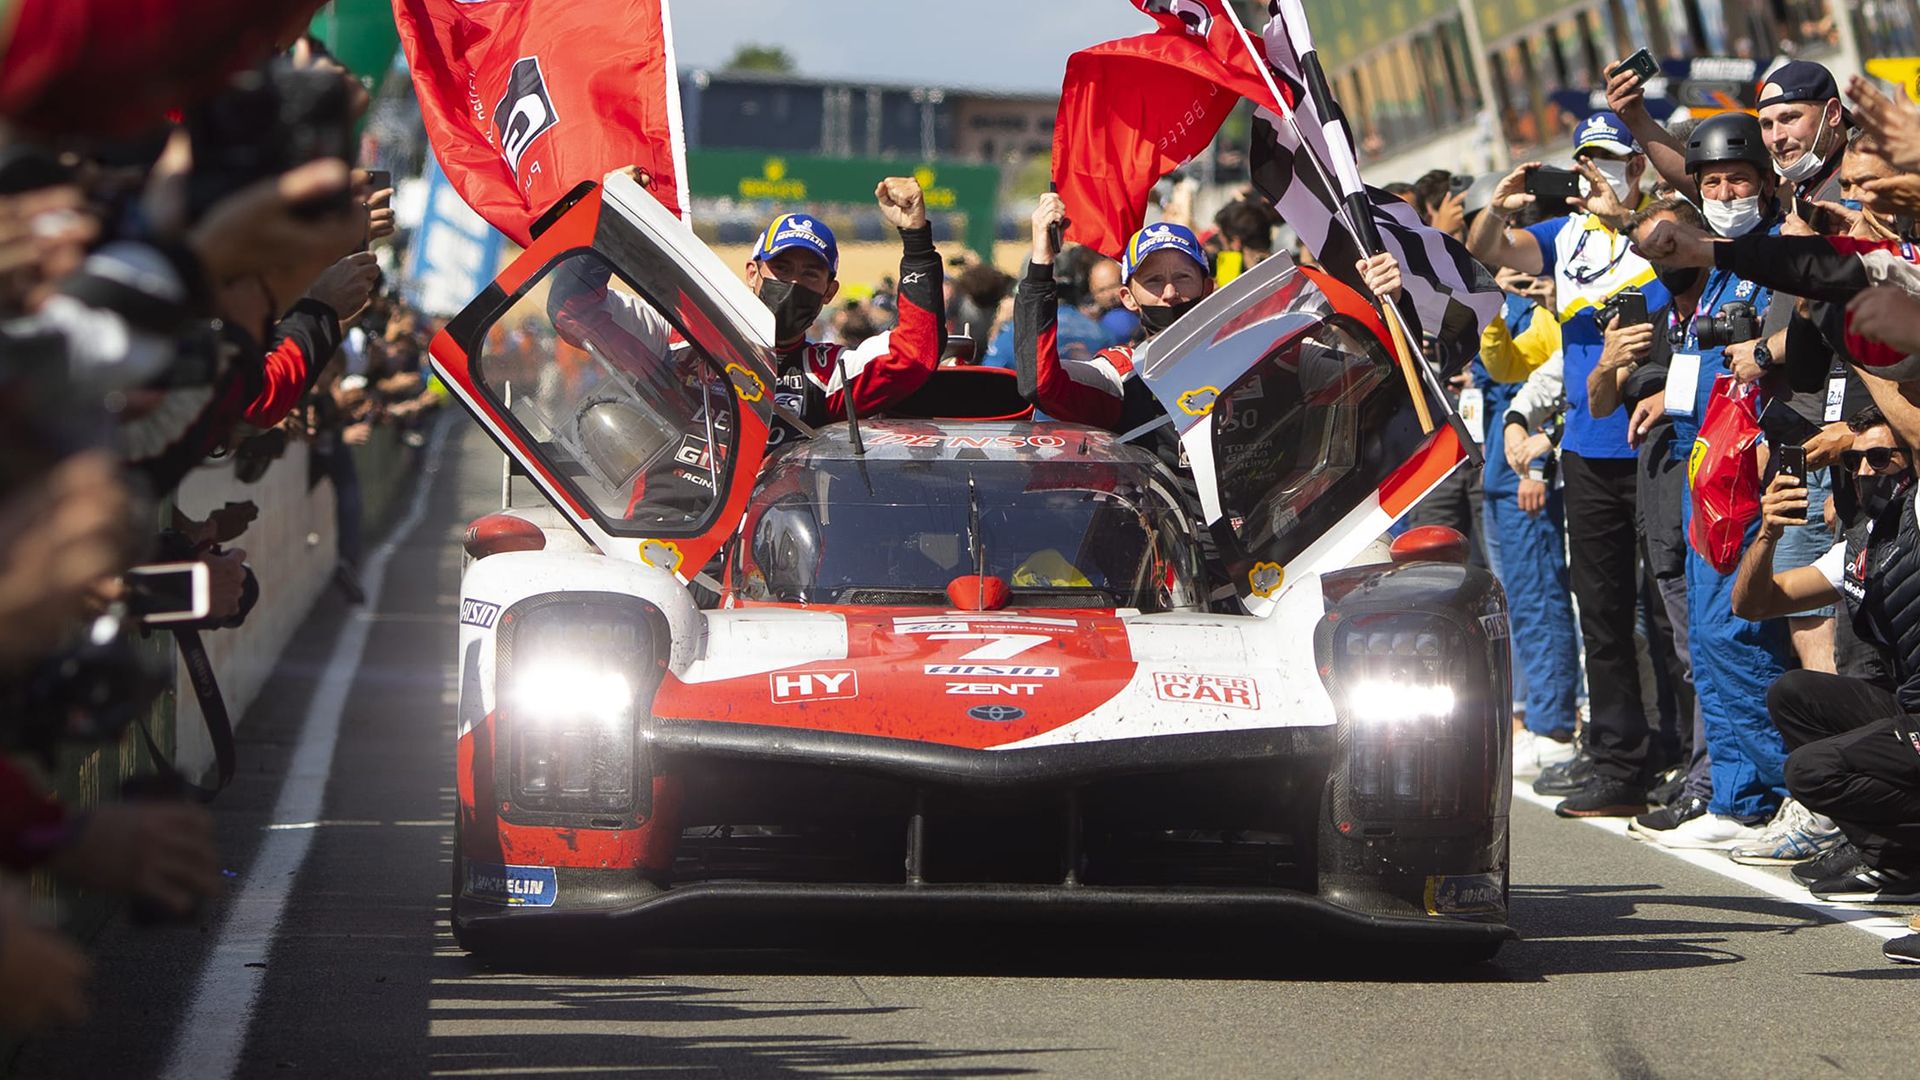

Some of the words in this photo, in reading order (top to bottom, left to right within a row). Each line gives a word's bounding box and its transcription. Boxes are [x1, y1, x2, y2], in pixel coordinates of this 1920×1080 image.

[775, 231, 828, 250] MICHELIN
[1138, 235, 1190, 254] MICHELIN
[863, 431, 1066, 449] DENSO
[462, 599, 499, 629] AISIN
[926, 633, 1053, 660] 7
[928, 666, 1056, 676] AISIN
[775, 672, 851, 697] HY
[945, 682, 1044, 696] ZENT
[1160, 674, 1249, 689] HYPER
[1163, 683, 1252, 706] CAR
